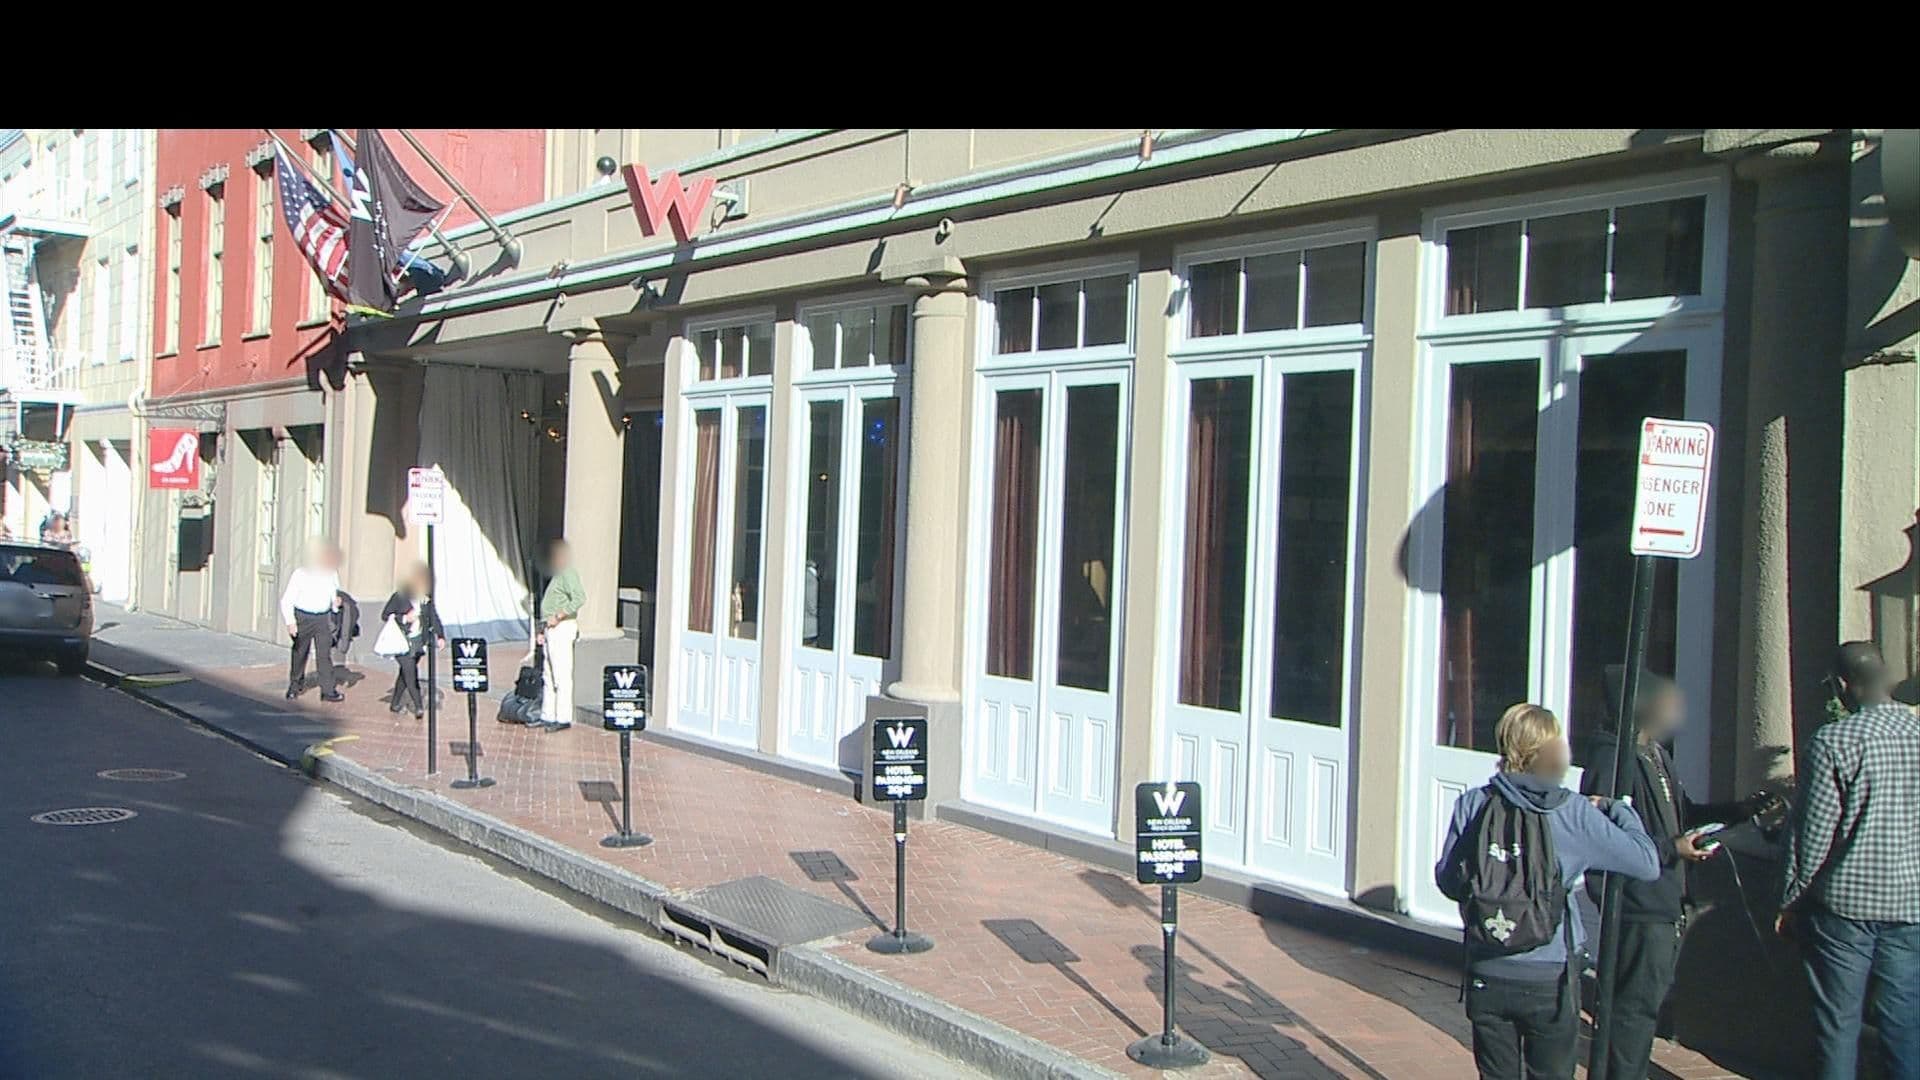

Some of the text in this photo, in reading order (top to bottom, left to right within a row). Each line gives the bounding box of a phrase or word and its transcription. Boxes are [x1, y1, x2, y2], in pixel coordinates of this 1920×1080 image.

[622, 164, 718, 243] W
[1644, 501, 1675, 518] ONE
[460, 643, 478, 658] W
[613, 672, 637, 689] W
[886, 727, 914, 749] W
[1152, 790, 1186, 817] W
[1152, 838, 1187, 850] HOTEL
[1140, 849, 1198, 863] PASSENGER
